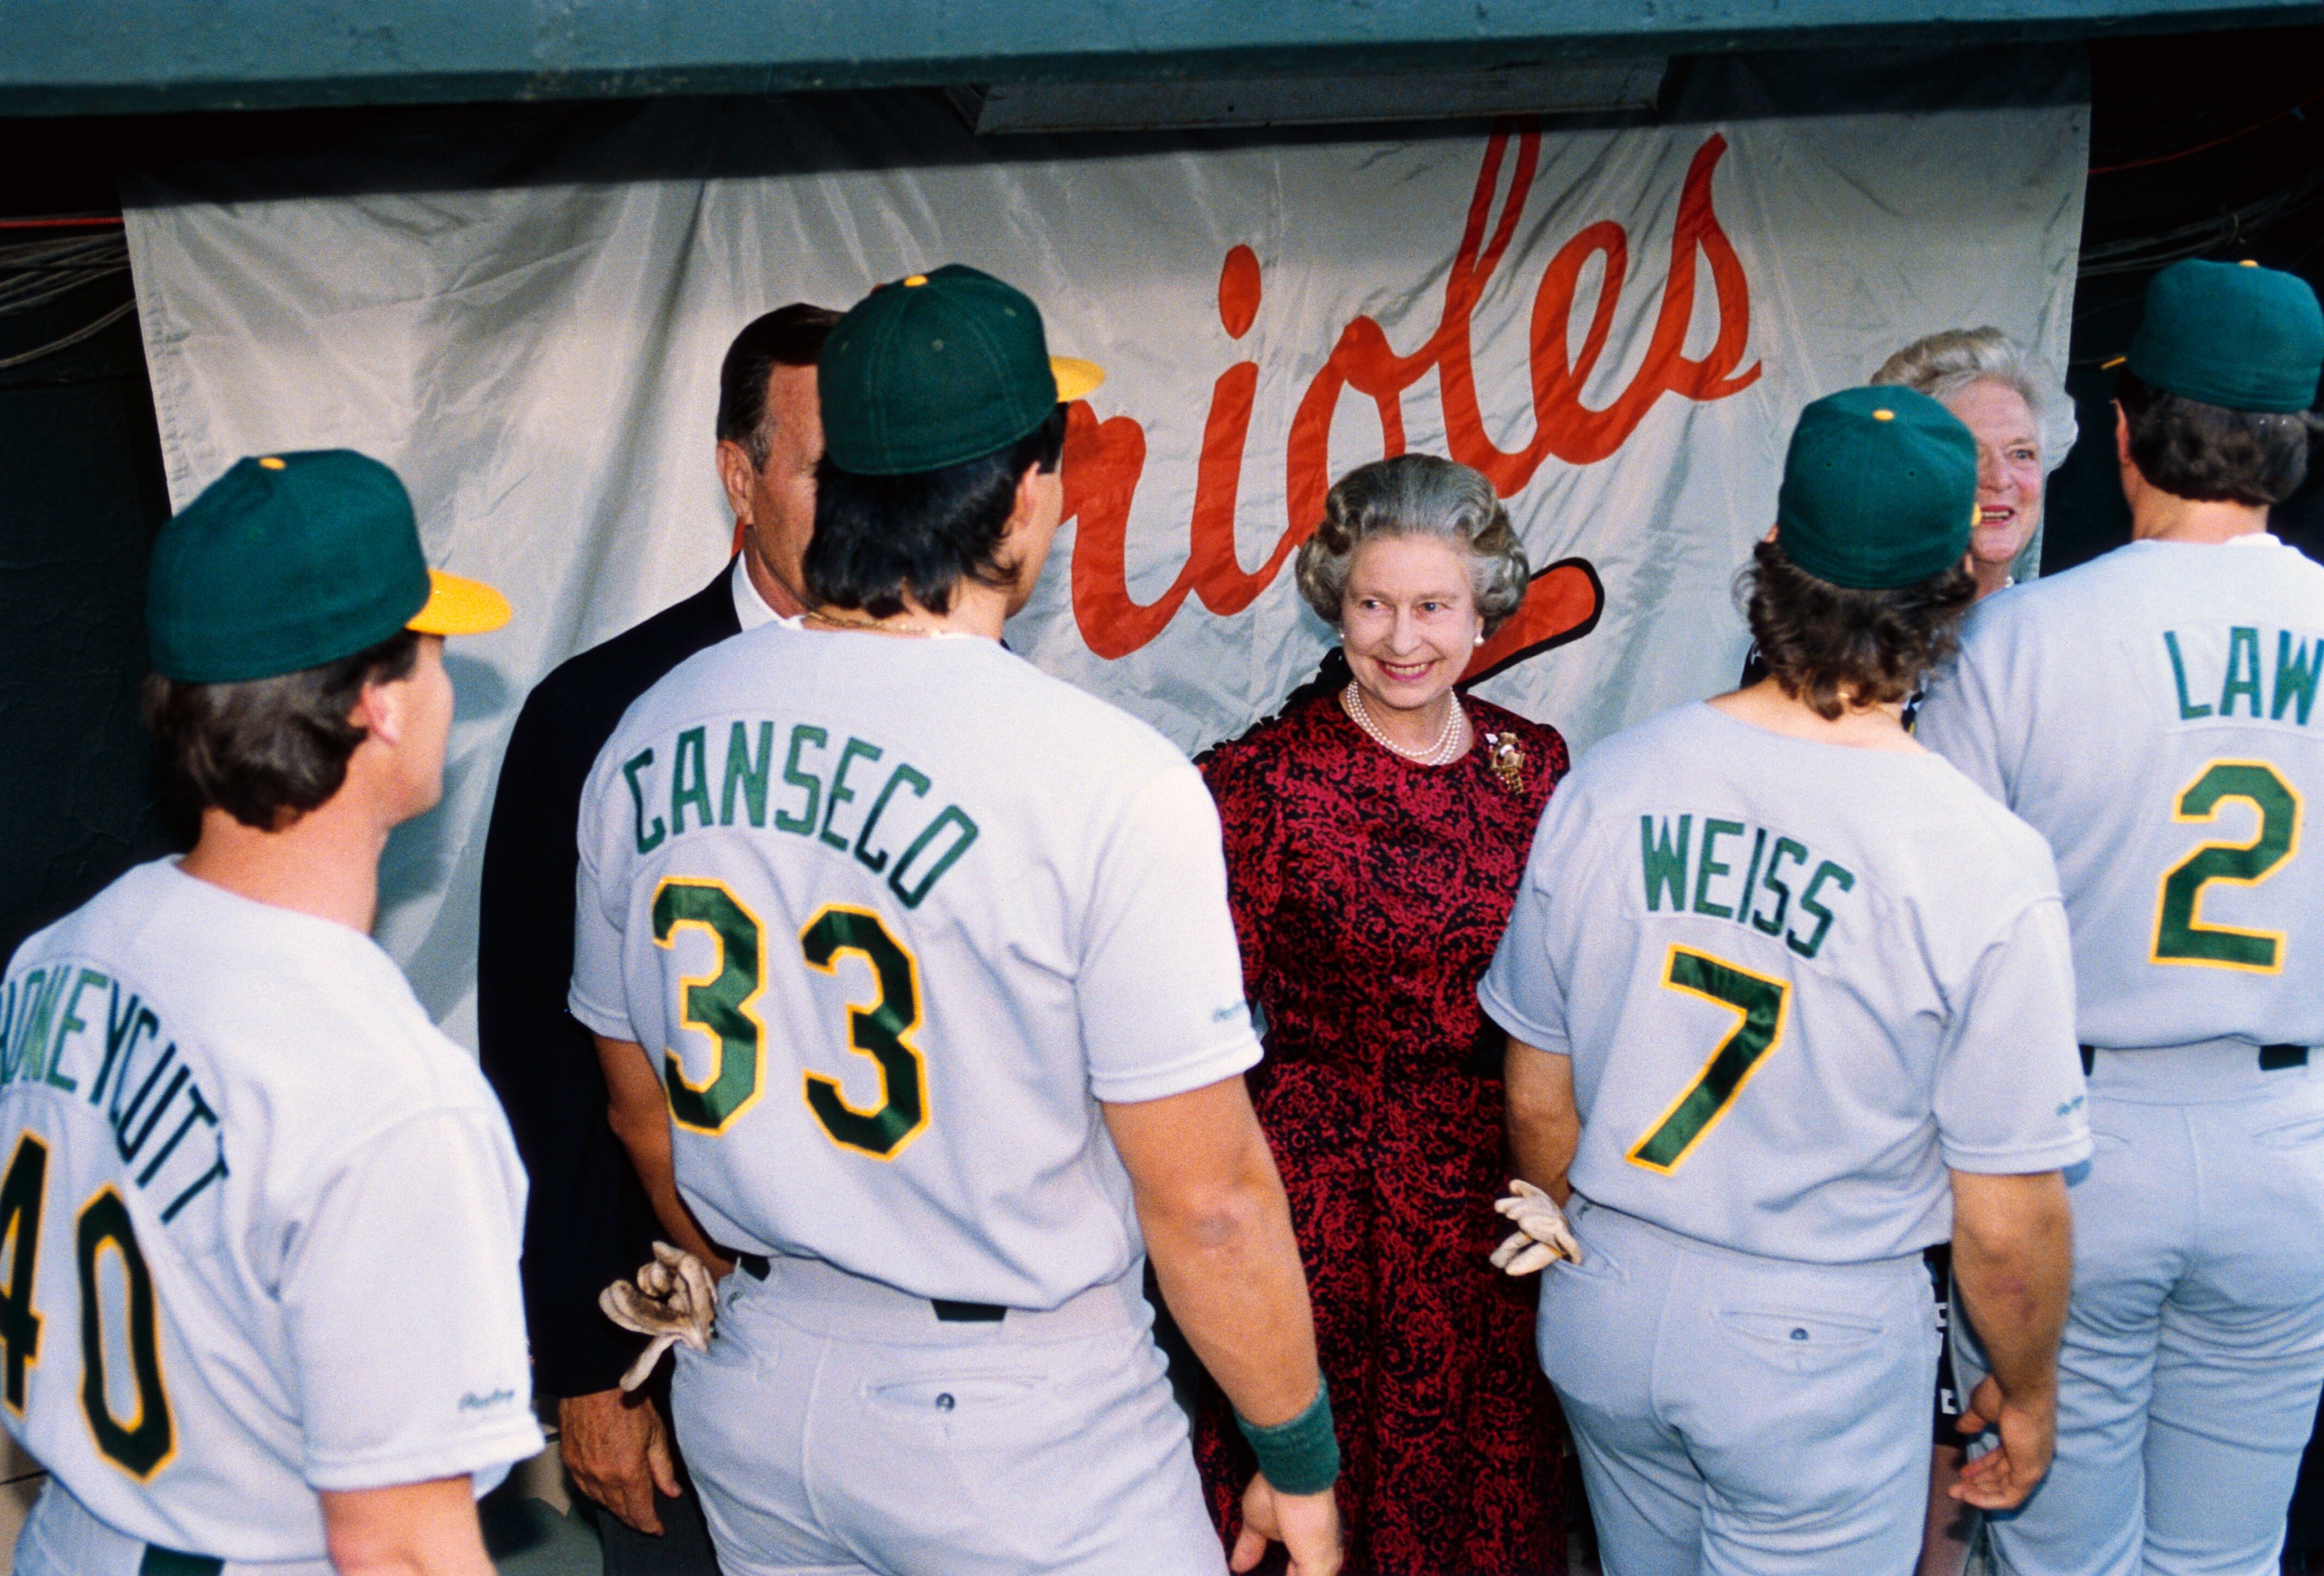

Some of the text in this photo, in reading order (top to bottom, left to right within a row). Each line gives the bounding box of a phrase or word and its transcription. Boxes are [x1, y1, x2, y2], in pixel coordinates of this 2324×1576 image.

[1056, 113, 1761, 660] rioles
[2163, 626, 2324, 726] LAW
[624, 720, 979, 909] CANSECO
[1640, 814, 1855, 960] WEISS
[2149, 758, 2304, 974] 2
[652, 876, 931, 1161] 33
[1625, 943, 1791, 1176] 7
[0, 1127, 178, 1485] 40
